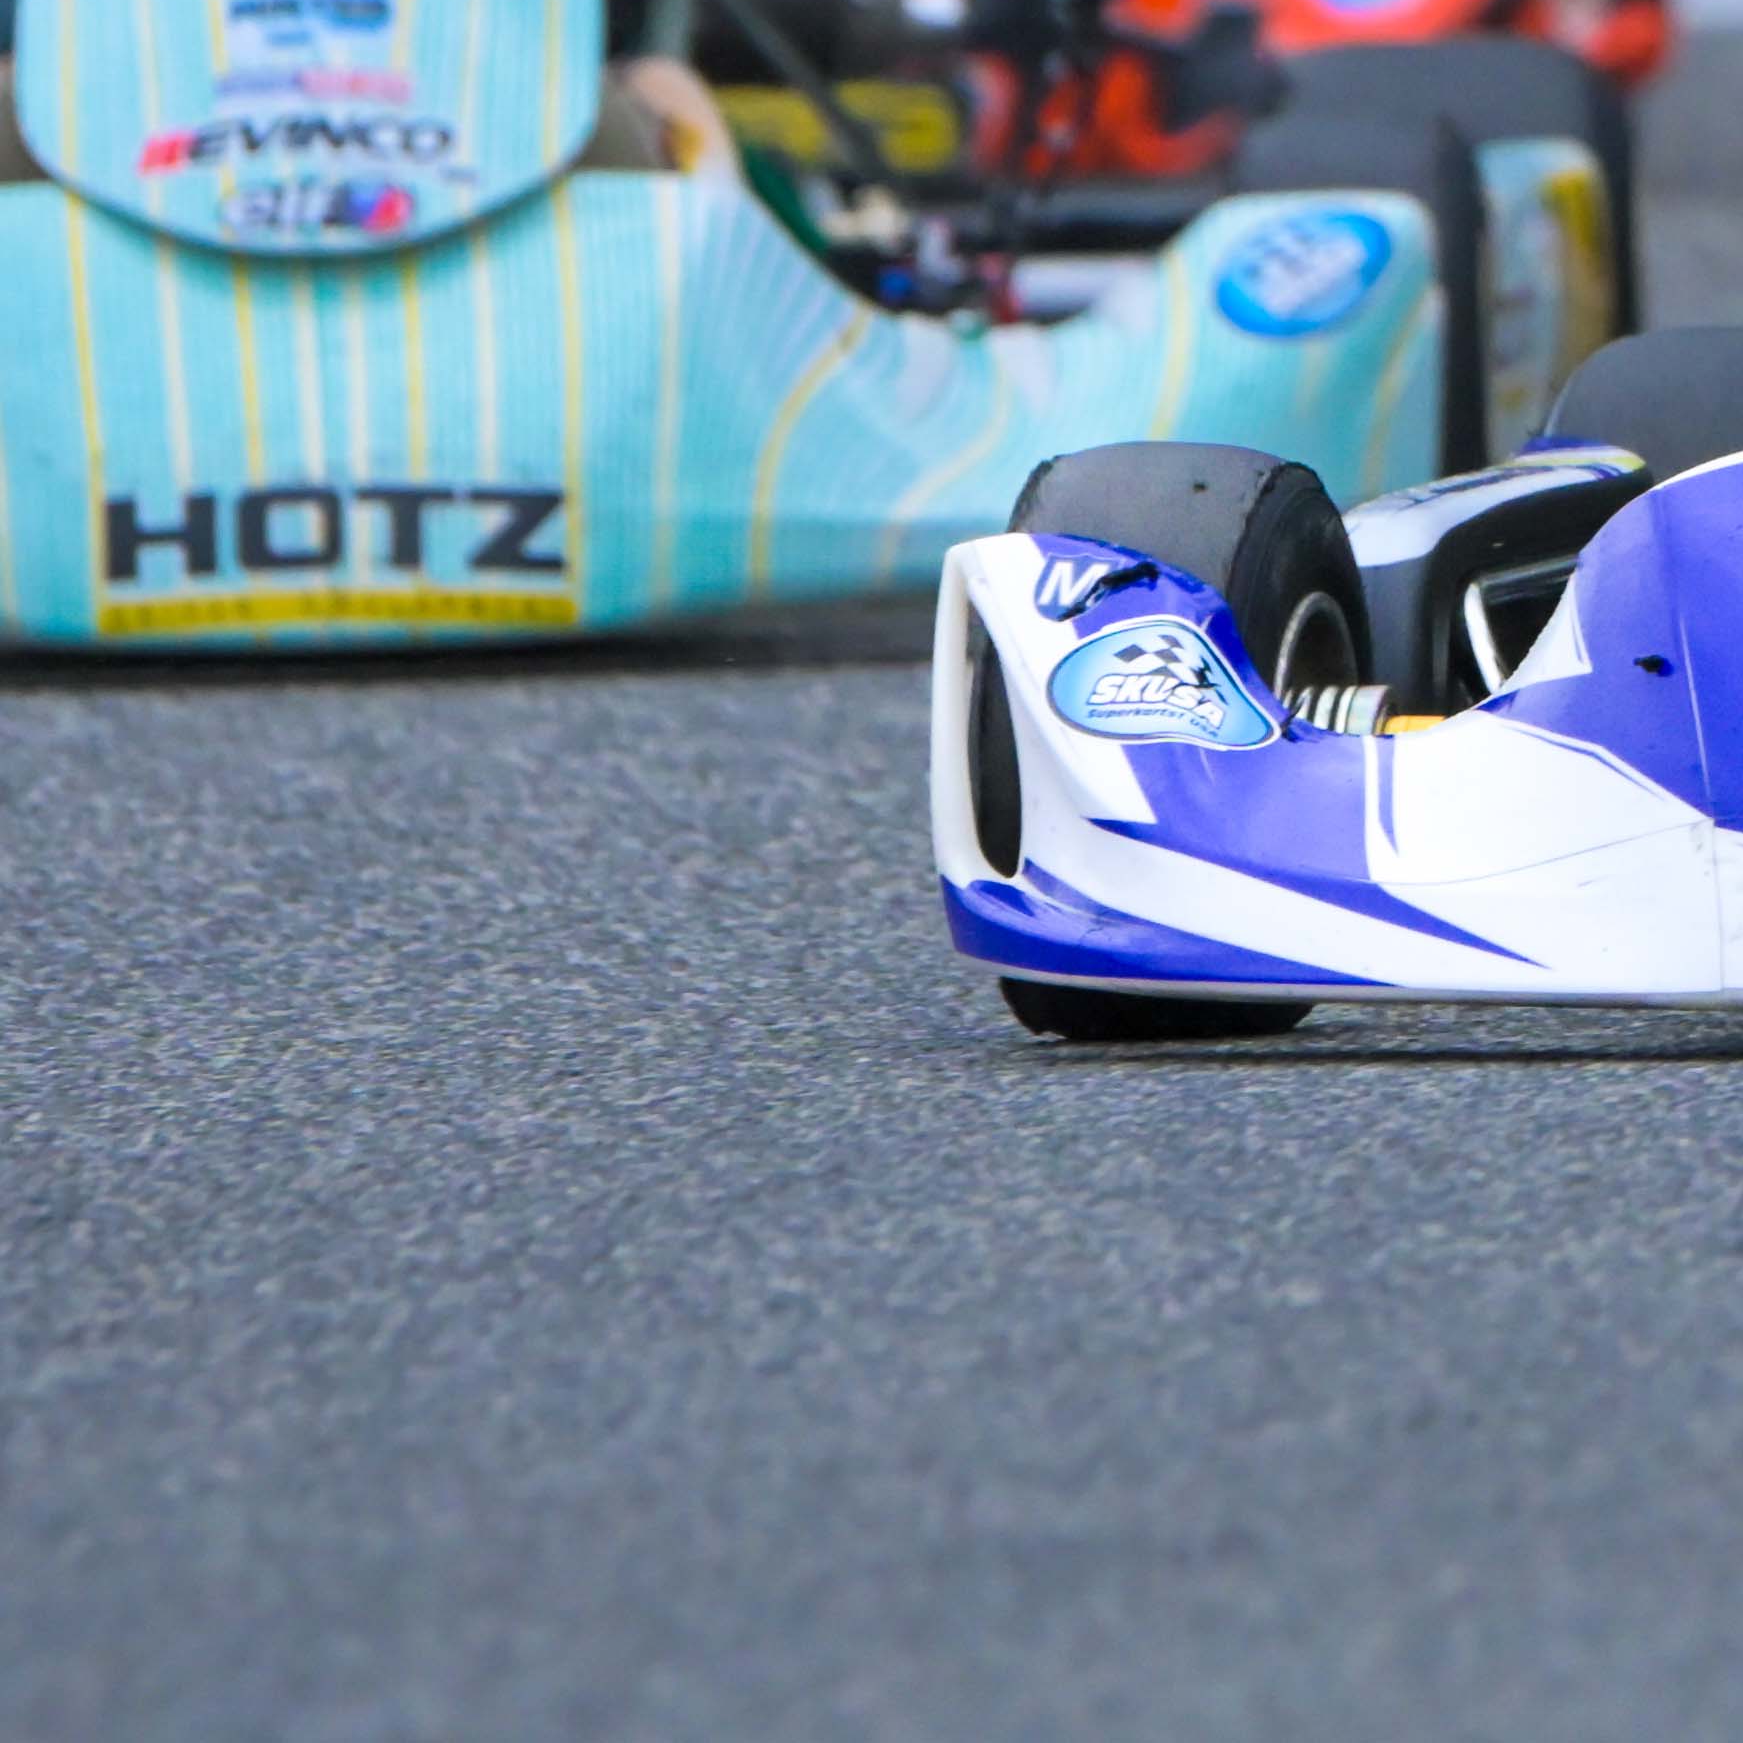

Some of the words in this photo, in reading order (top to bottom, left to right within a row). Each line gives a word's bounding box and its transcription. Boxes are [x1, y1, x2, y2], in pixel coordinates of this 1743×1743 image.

[105, 488, 567, 581] HOTZ
[1087, 672, 1226, 730] SKUSA
[1189, 718, 1219, 738] USA
